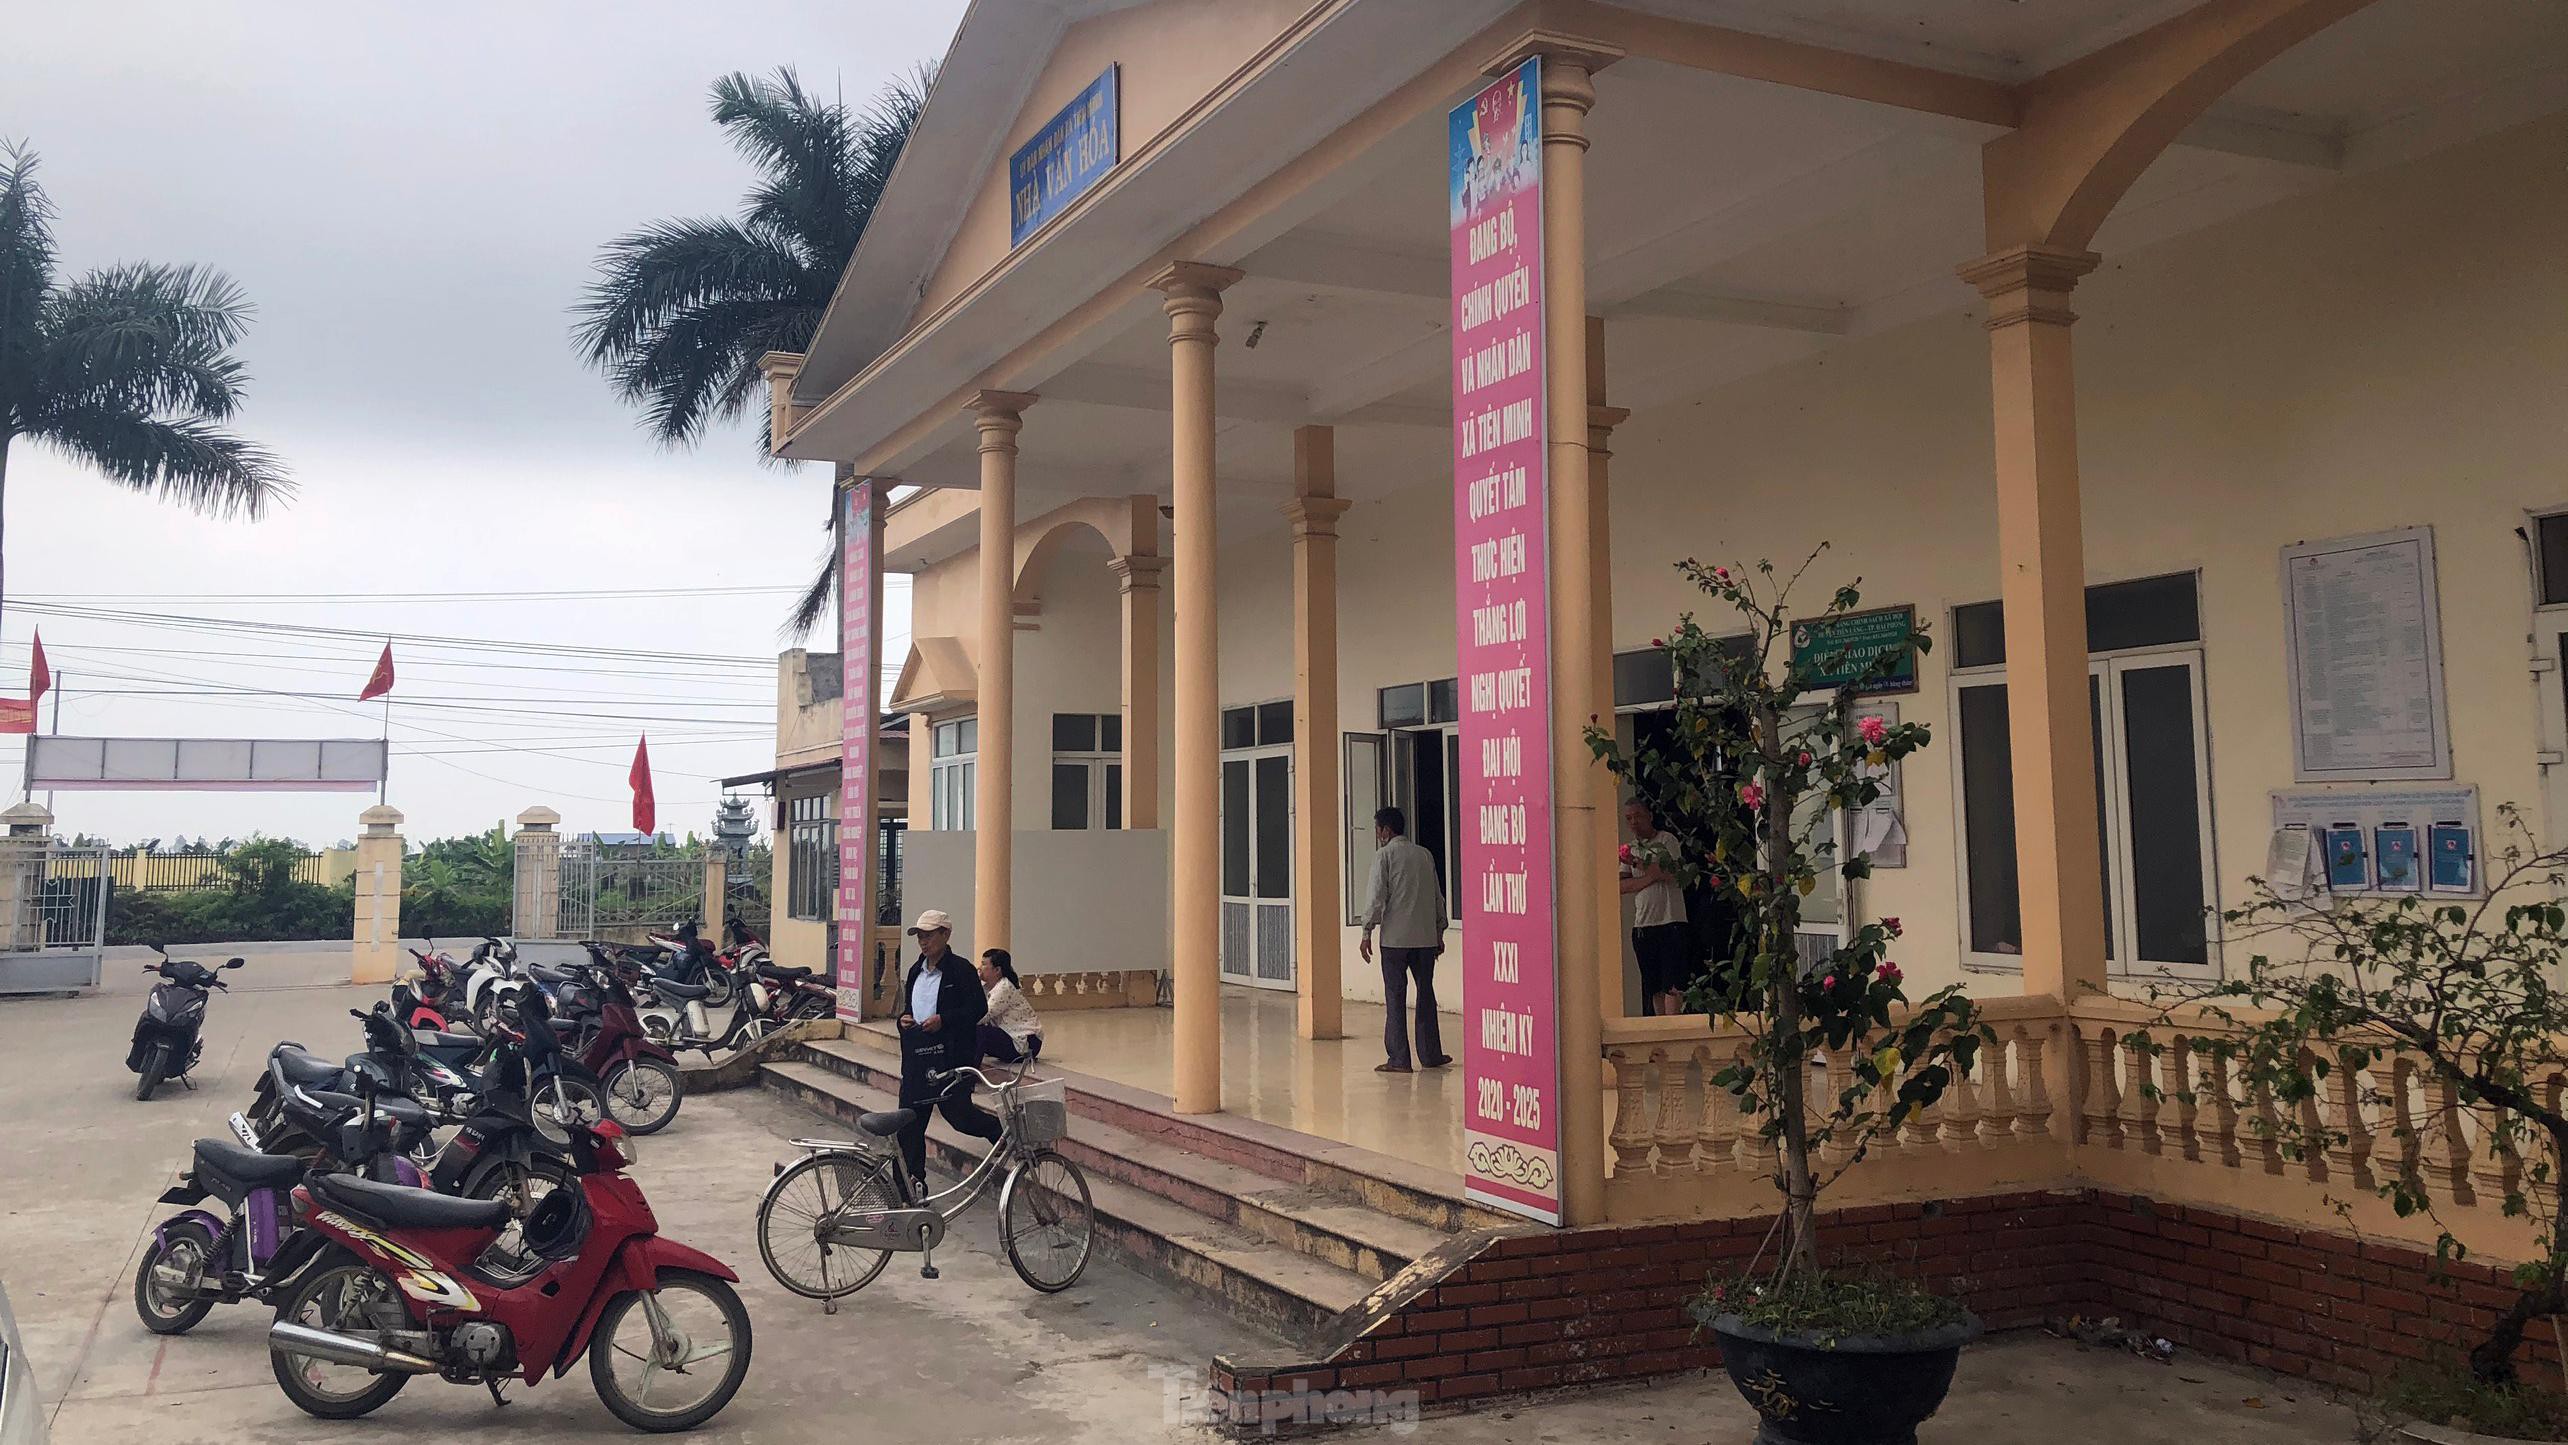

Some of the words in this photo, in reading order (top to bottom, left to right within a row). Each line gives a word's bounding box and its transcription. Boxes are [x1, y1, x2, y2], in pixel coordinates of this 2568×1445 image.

[1015, 169, 1041, 228] NHÀ
[1045, 146, 1073, 200] VĂN
[1078, 115, 1109, 177] HÓA
[1469, 208, 1498, 266] ĐẢNG
[1499, 200, 1518, 255] BỘ,
[1461, 281, 1492, 332] CHÍNH
[1494, 255, 1529, 321] QUYỀN
[1461, 348, 1475, 395] VÀ
[1477, 337, 1506, 389] NHÂN
[1508, 327, 1531, 378] DÂN
[1462, 411, 1476, 459] XÃ
[1478, 404, 1500, 454] TIÊN
[1503, 398, 1532, 445] MINH
[1469, 461, 1501, 523] QUYẾT
[1502, 461, 1526, 511] TÂM
[1471, 537, 1498, 589] THỰC
[1500, 527, 1526, 584] HIỆN
[1473, 593, 1507, 648] THẮNG
[1509, 597, 1527, 650] LỢI
[1471, 672, 1496, 720] NGHỊ
[1498, 653, 1531, 714] QUYẾT
[1482, 738, 1500, 786] ĐẠI
[1502, 728, 1521, 786] HỘI
[1480, 788, 1509, 845] ĐẢNG
[1510, 795, 1526, 854] BỘ
[1482, 858, 1503, 913] LẦN
[1505, 861, 1528, 915] THỨ
[1492, 941, 1519, 984] XXXI
[1481, 1001, 1517, 1062] NHIỆM
[1519, 1005, 1534, 1057] KỲ
[1477, 1076, 1504, 1122] 2020
[1513, 1084, 1540, 1131] 2025
